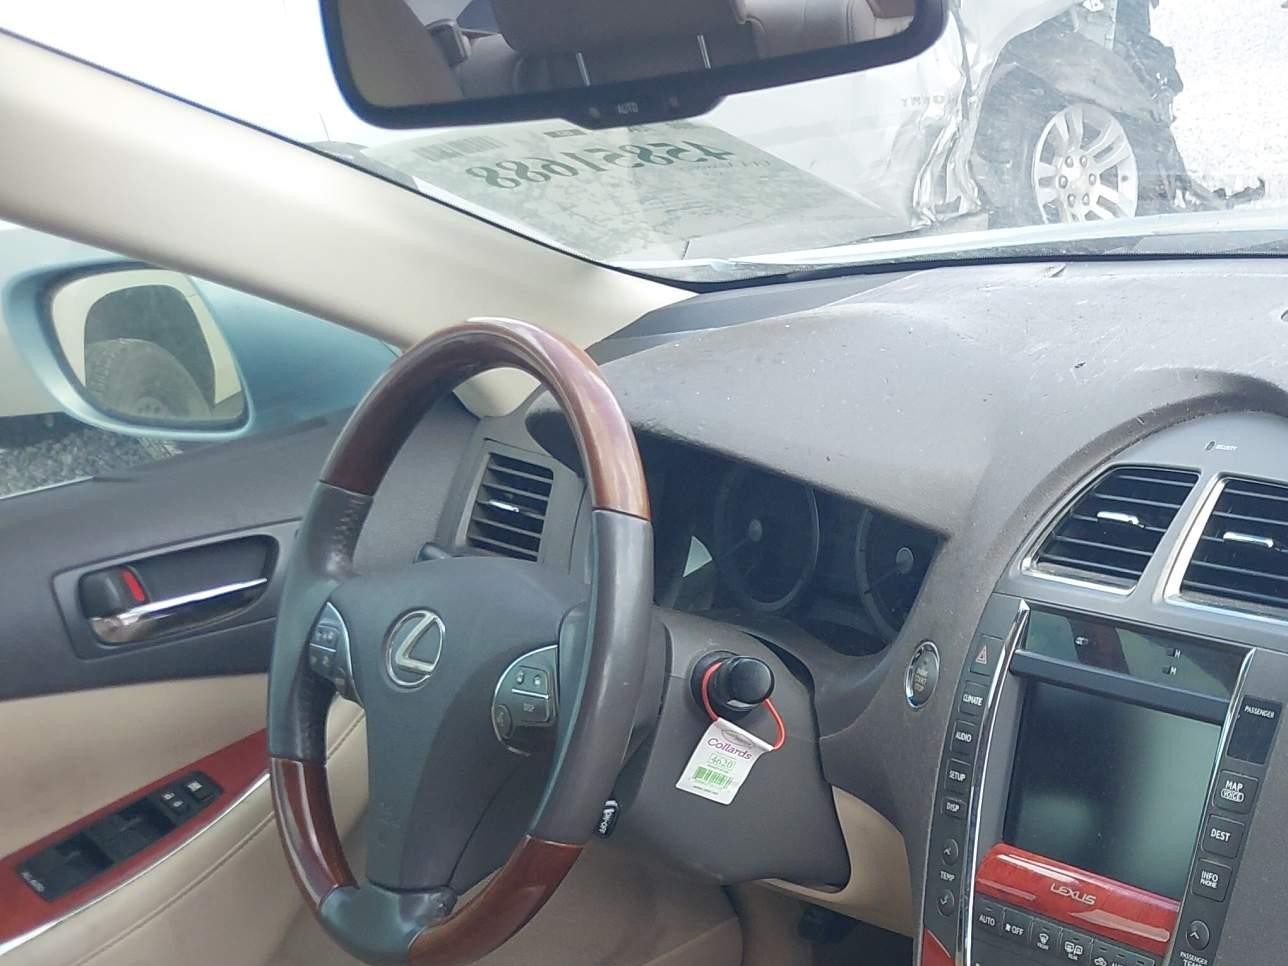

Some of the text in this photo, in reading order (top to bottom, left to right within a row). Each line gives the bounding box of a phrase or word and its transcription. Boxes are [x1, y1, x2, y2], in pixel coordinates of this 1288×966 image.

[1244, 705, 1275, 719] PASSENGER
[955, 731, 972, 743] AUDIO
[707, 737, 752, 760] Collards
[949, 769, 966, 782] SETUP
[1225, 780, 1243, 791] MAP
[1210, 828, 1231, 842] DEST
[1201, 871, 1219, 882] INFO
[1050, 882, 1097, 905] LEXUS
[979, 914, 996, 927] AUTO
[1011, 925, 1024, 937] OFF
[1180, 951, 1208, 965] PASSENGER
